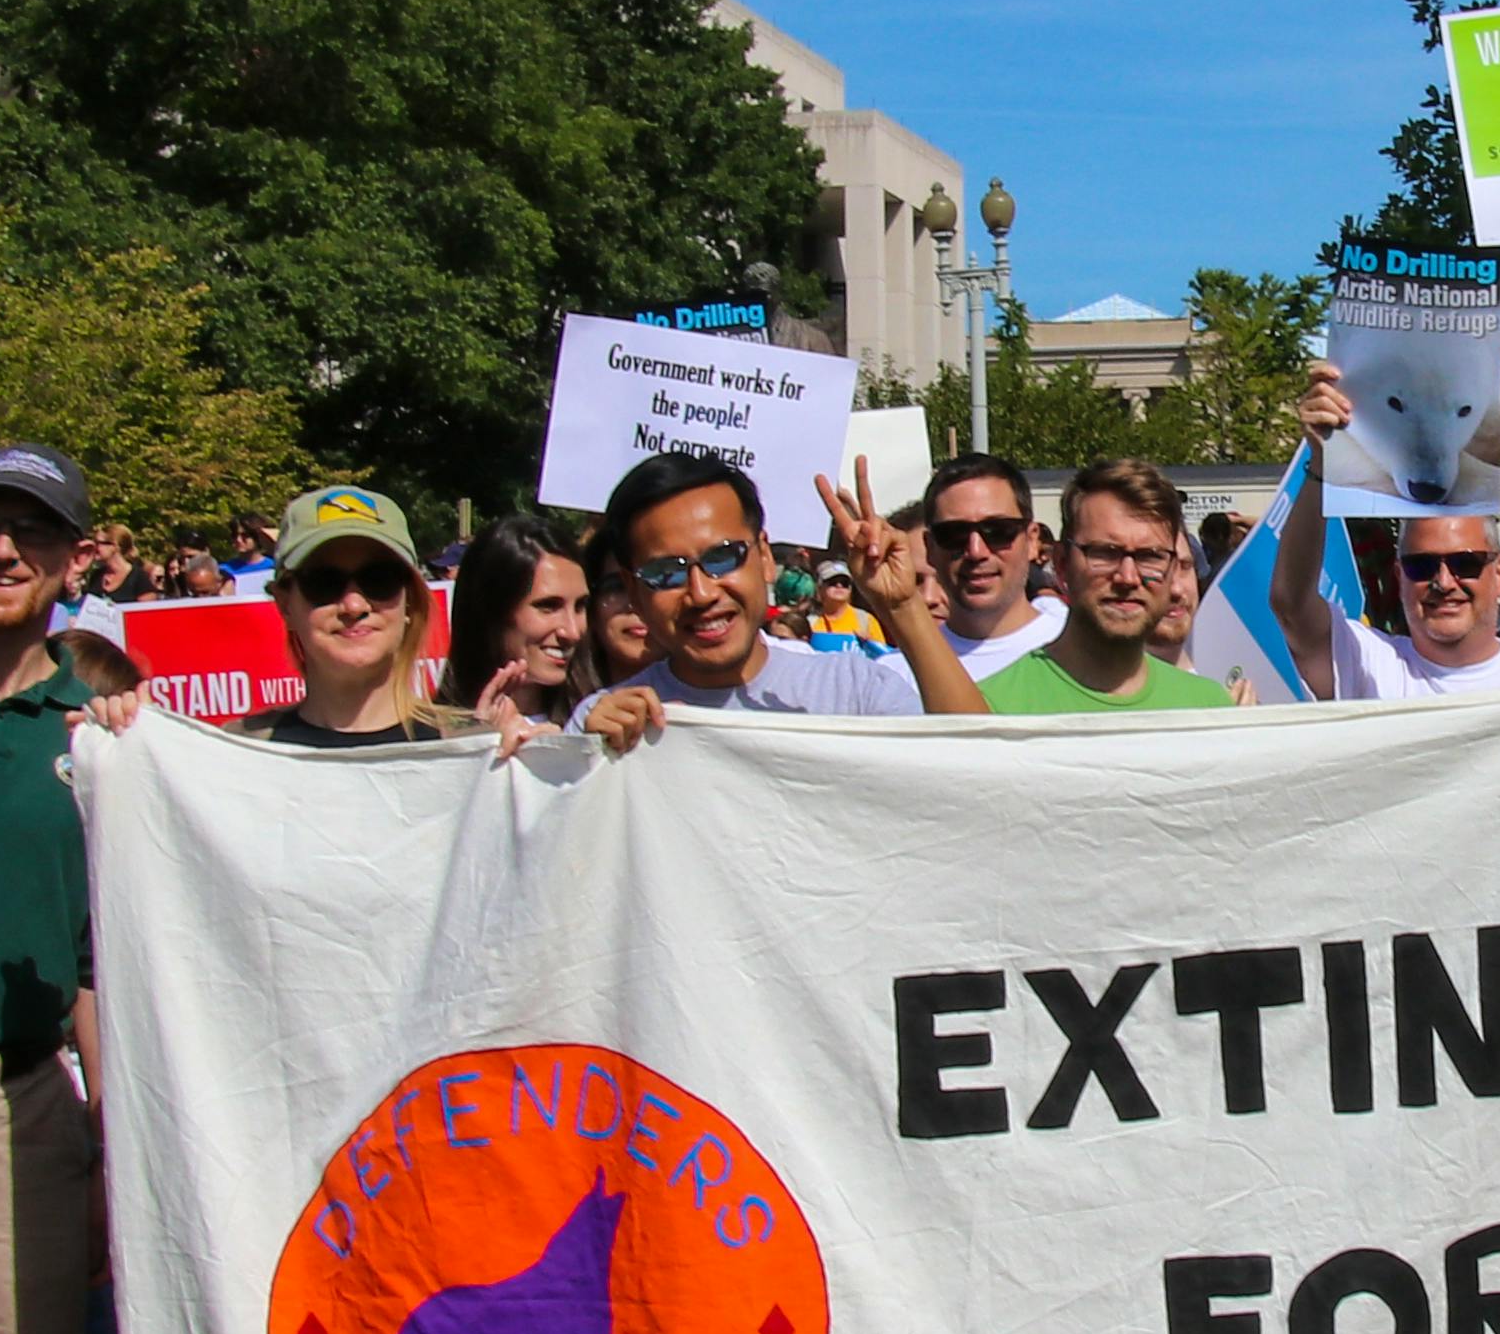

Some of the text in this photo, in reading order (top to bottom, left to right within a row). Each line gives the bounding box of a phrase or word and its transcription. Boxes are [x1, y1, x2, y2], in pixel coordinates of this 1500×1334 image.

[1341, 244, 1498, 285] No Drilling
[1337, 275, 1498, 308] Arctic National
[636, 302, 766, 331] No Drilling
[1335, 301, 1498, 338] Wildlife Refuge
[608, 343, 805, 401] Government works for
[652, 390, 752, 431] the people!
[633, 422, 665, 454] Not
[151, 670, 251, 716] STAND
[313, 1061, 776, 1259] DEFENDERS
